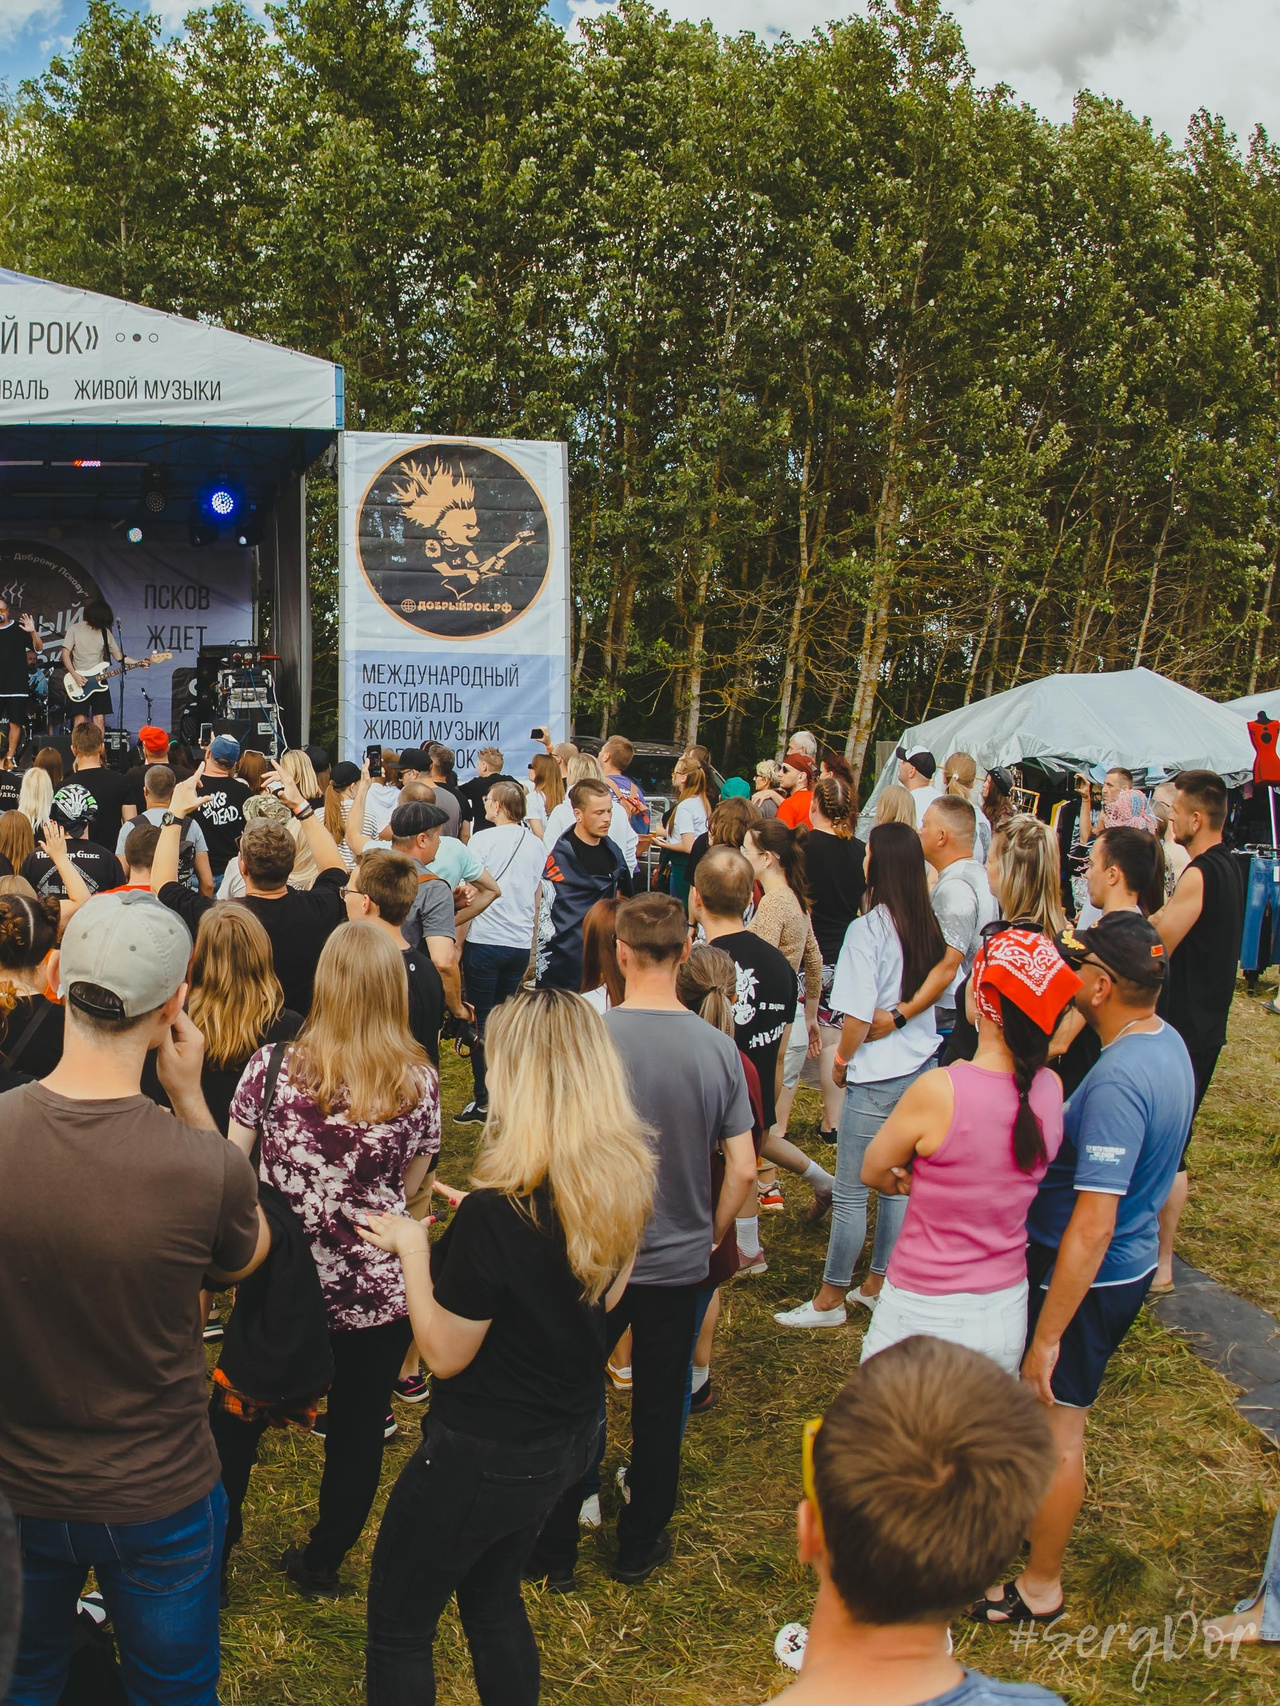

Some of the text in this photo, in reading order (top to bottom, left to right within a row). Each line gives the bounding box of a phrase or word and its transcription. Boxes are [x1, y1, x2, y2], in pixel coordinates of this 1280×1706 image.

[28, 321, 99, 355] РОК»
[74, 375, 138, 400] ЖИВОЙ
[144, 379, 221, 401] МУЗЫКИ
[13, 552, 58, 571] Доброму
[144, 584, 210, 610] ПСКОВ
[417, 600, 513, 614] ДОБРЫЙРОК.РФ
[146, 625, 208, 653] ЖДЕТ
[361, 663, 520, 690] МЕЖДУНАРОДНЫЙ
[362, 691, 464, 714] ФЕСТИВАЛЬ
[363, 716, 500, 742] ЖИВОЙ МУЗЫКИ
[211, 805, 242, 825] DEAD.
